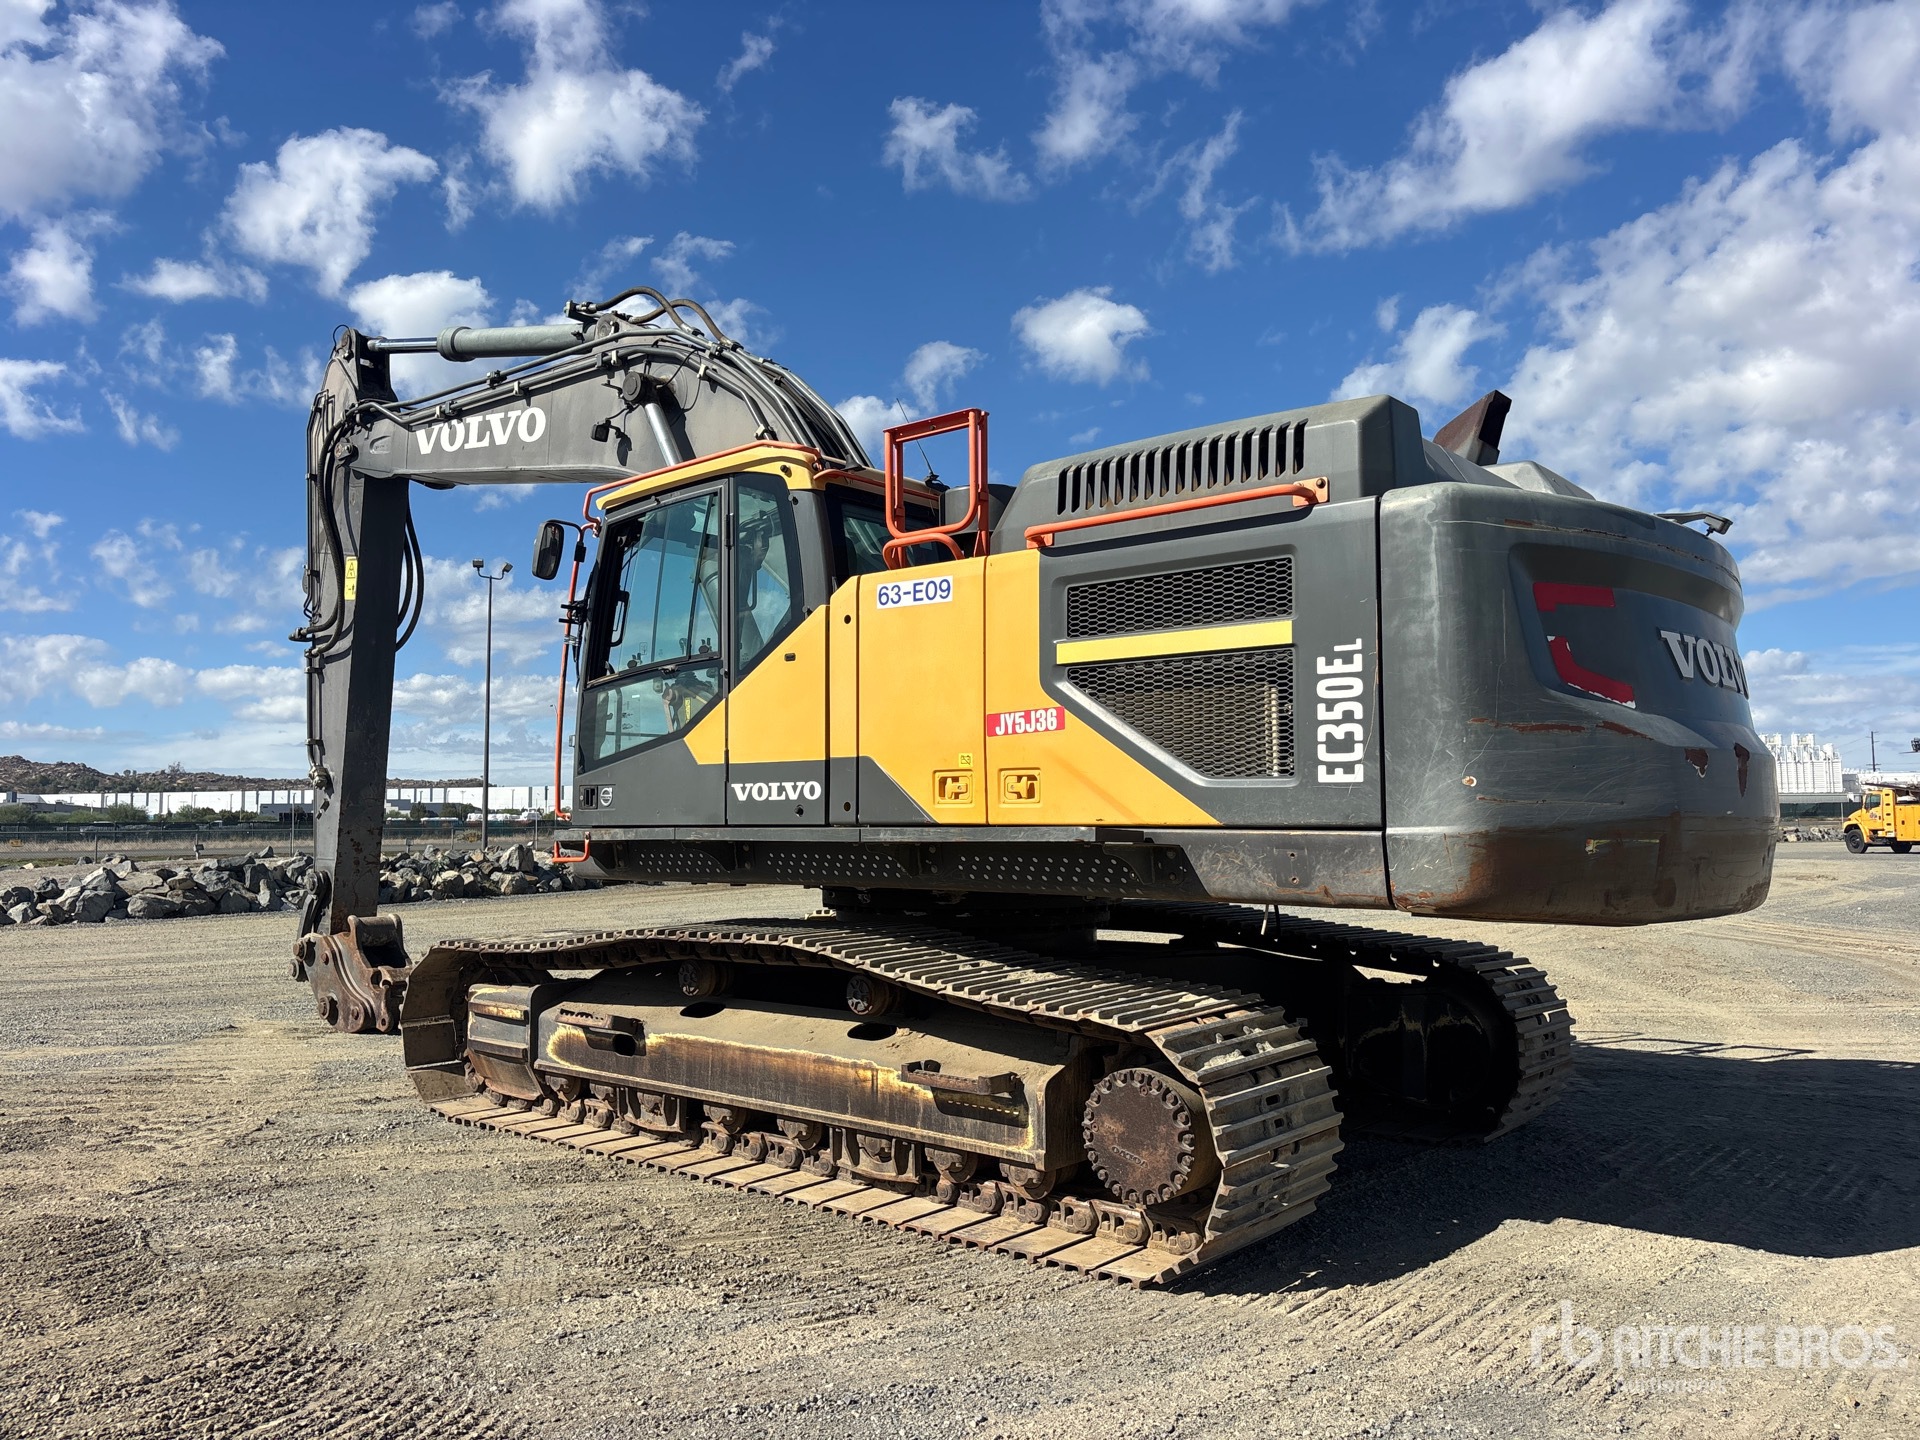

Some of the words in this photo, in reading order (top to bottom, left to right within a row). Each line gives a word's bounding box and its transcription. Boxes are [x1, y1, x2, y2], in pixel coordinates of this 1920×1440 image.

[416, 407, 547, 455] VOLVO
[878, 578, 951, 606] 63-E09
[1660, 630, 1749, 697] VOLV
[995, 708, 1058, 736] JY5J36
[1316, 638, 1364, 783] EC350EL
[731, 781, 822, 801] VOLVO
